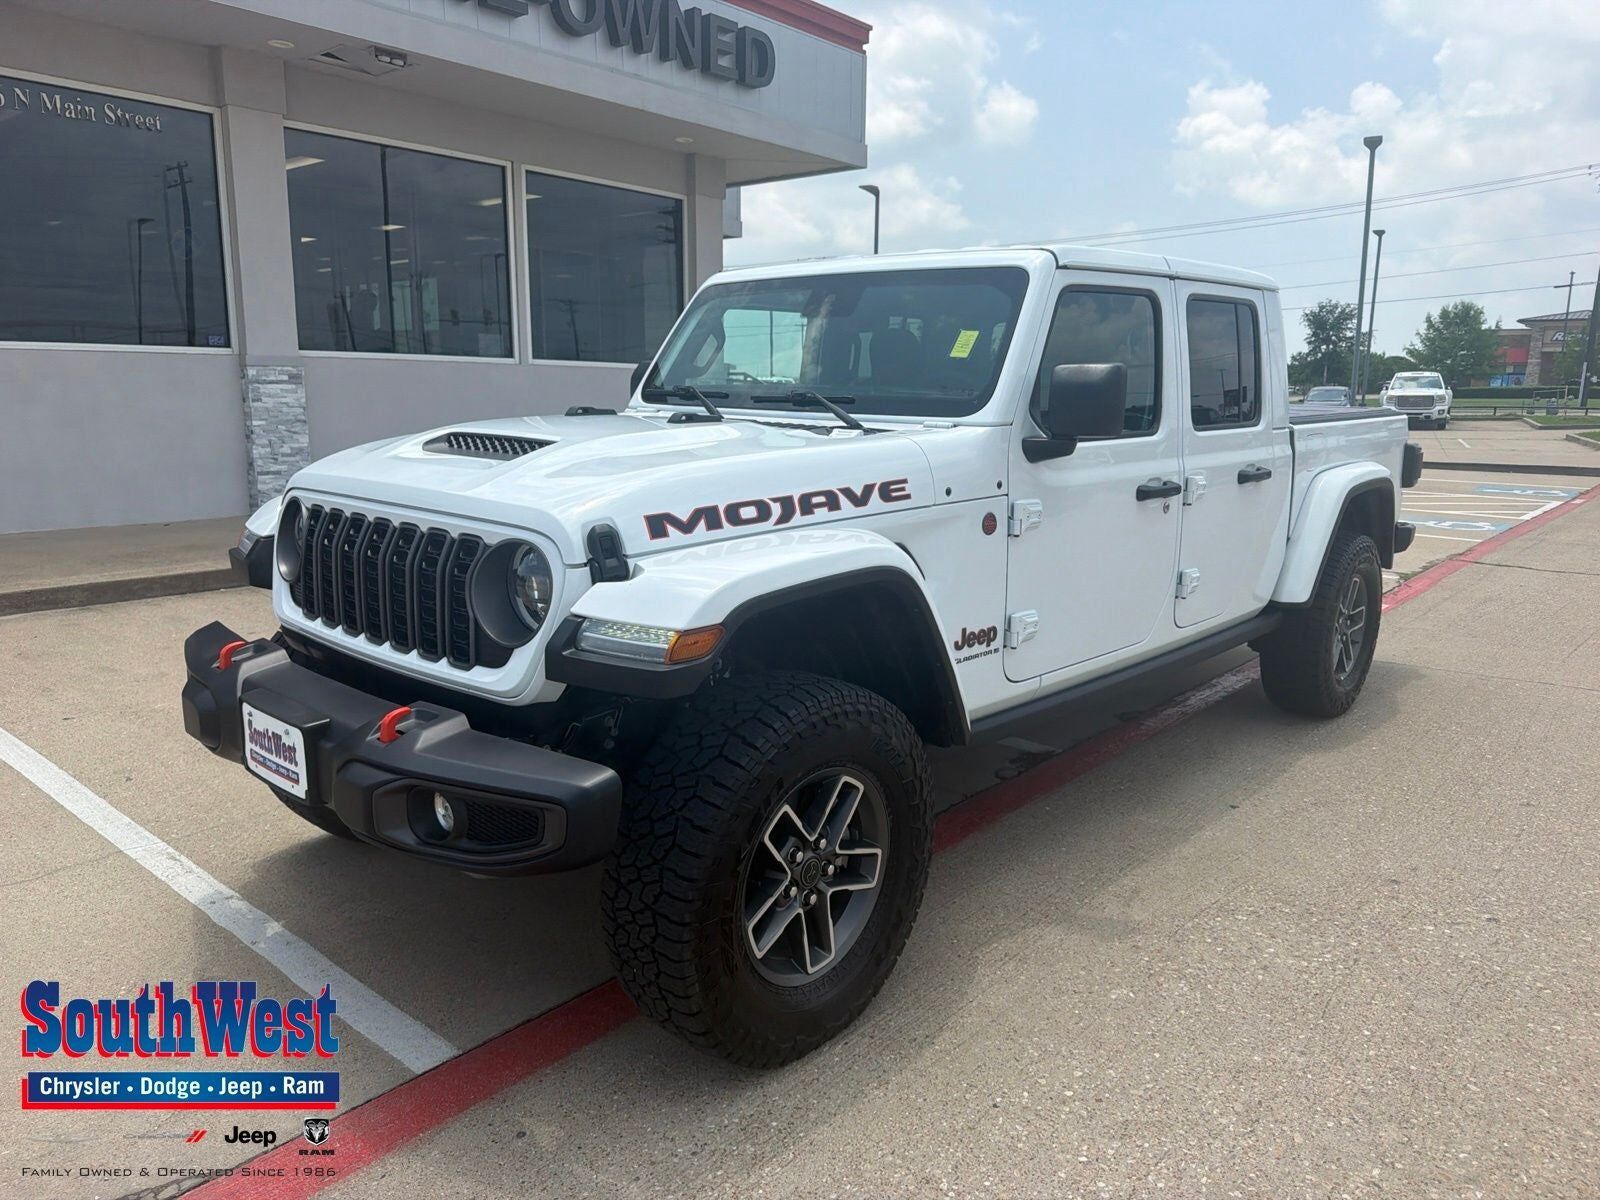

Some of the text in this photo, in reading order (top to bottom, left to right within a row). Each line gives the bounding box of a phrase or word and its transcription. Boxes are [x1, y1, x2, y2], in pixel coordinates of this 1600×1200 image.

[479, 0, 776, 89] OWNED
[13, 87, 30, 110] N
[40, 91, 97, 122] Main
[103, 102, 162, 132] Street
[643, 478, 912, 541] MOJAVE
[953, 625, 998, 651] Jeep
[248, 718, 299, 768] SouthWest
